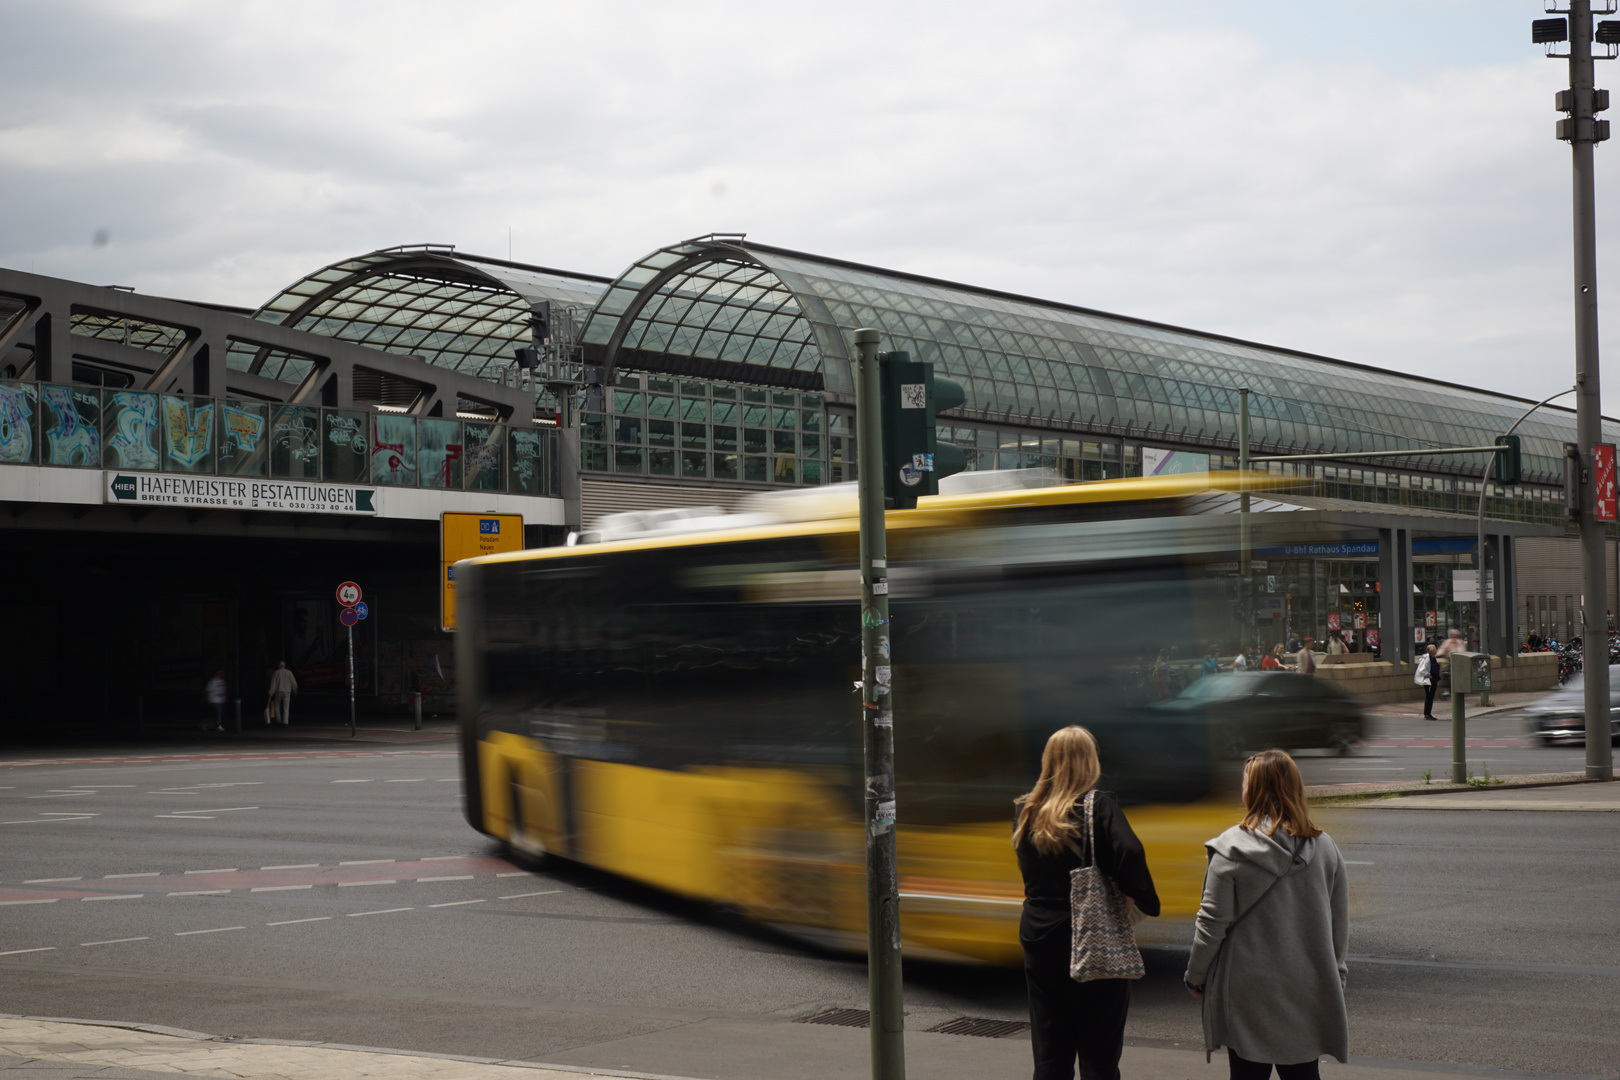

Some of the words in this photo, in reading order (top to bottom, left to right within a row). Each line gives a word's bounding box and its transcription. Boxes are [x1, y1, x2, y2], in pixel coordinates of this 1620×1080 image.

[1596, 455, 1614, 495] BAUHAUS
[115, 483, 136, 491] HIER
[141, 477, 246, 498] HAFEMEISTER
[252, 483, 354, 503] BESTATTUNGEN
[142, 494, 178, 502] BREITE
[183, 496, 228, 505] STRASSE
[289, 502, 325, 510] 030/333
[1285, 545, 1307, 554] U-Bhf
[1309, 545, 1340, 554] Rathaus
[1342, 544, 1376, 555] Spandau
